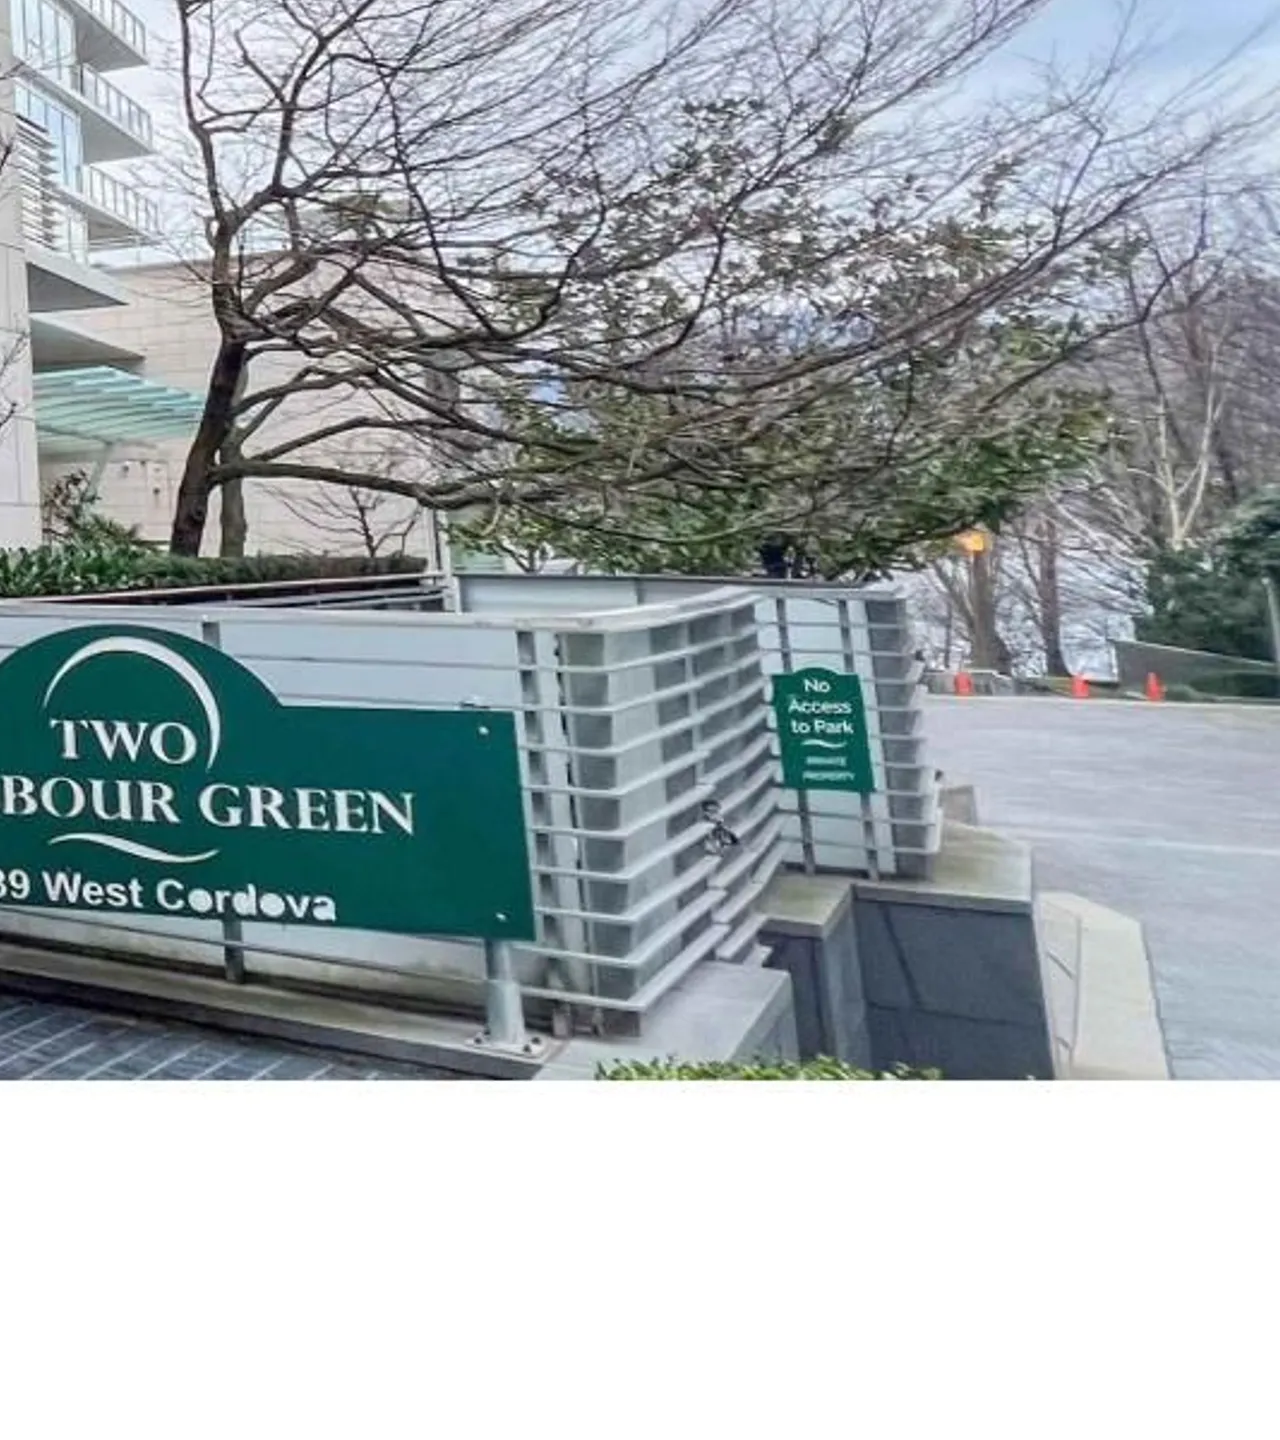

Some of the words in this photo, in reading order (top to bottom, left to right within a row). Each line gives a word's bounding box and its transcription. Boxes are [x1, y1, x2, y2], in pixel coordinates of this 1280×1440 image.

[802, 678, 831, 693] No
[788, 698, 852, 715] Access
[49, 717, 197, 765] TWO
[791, 719, 811, 734] to
[814, 719, 854, 735] Park
[198, 782, 416, 836] GREEN
[42, 869, 144, 909] West
[156, 877, 337, 922] Cordova
